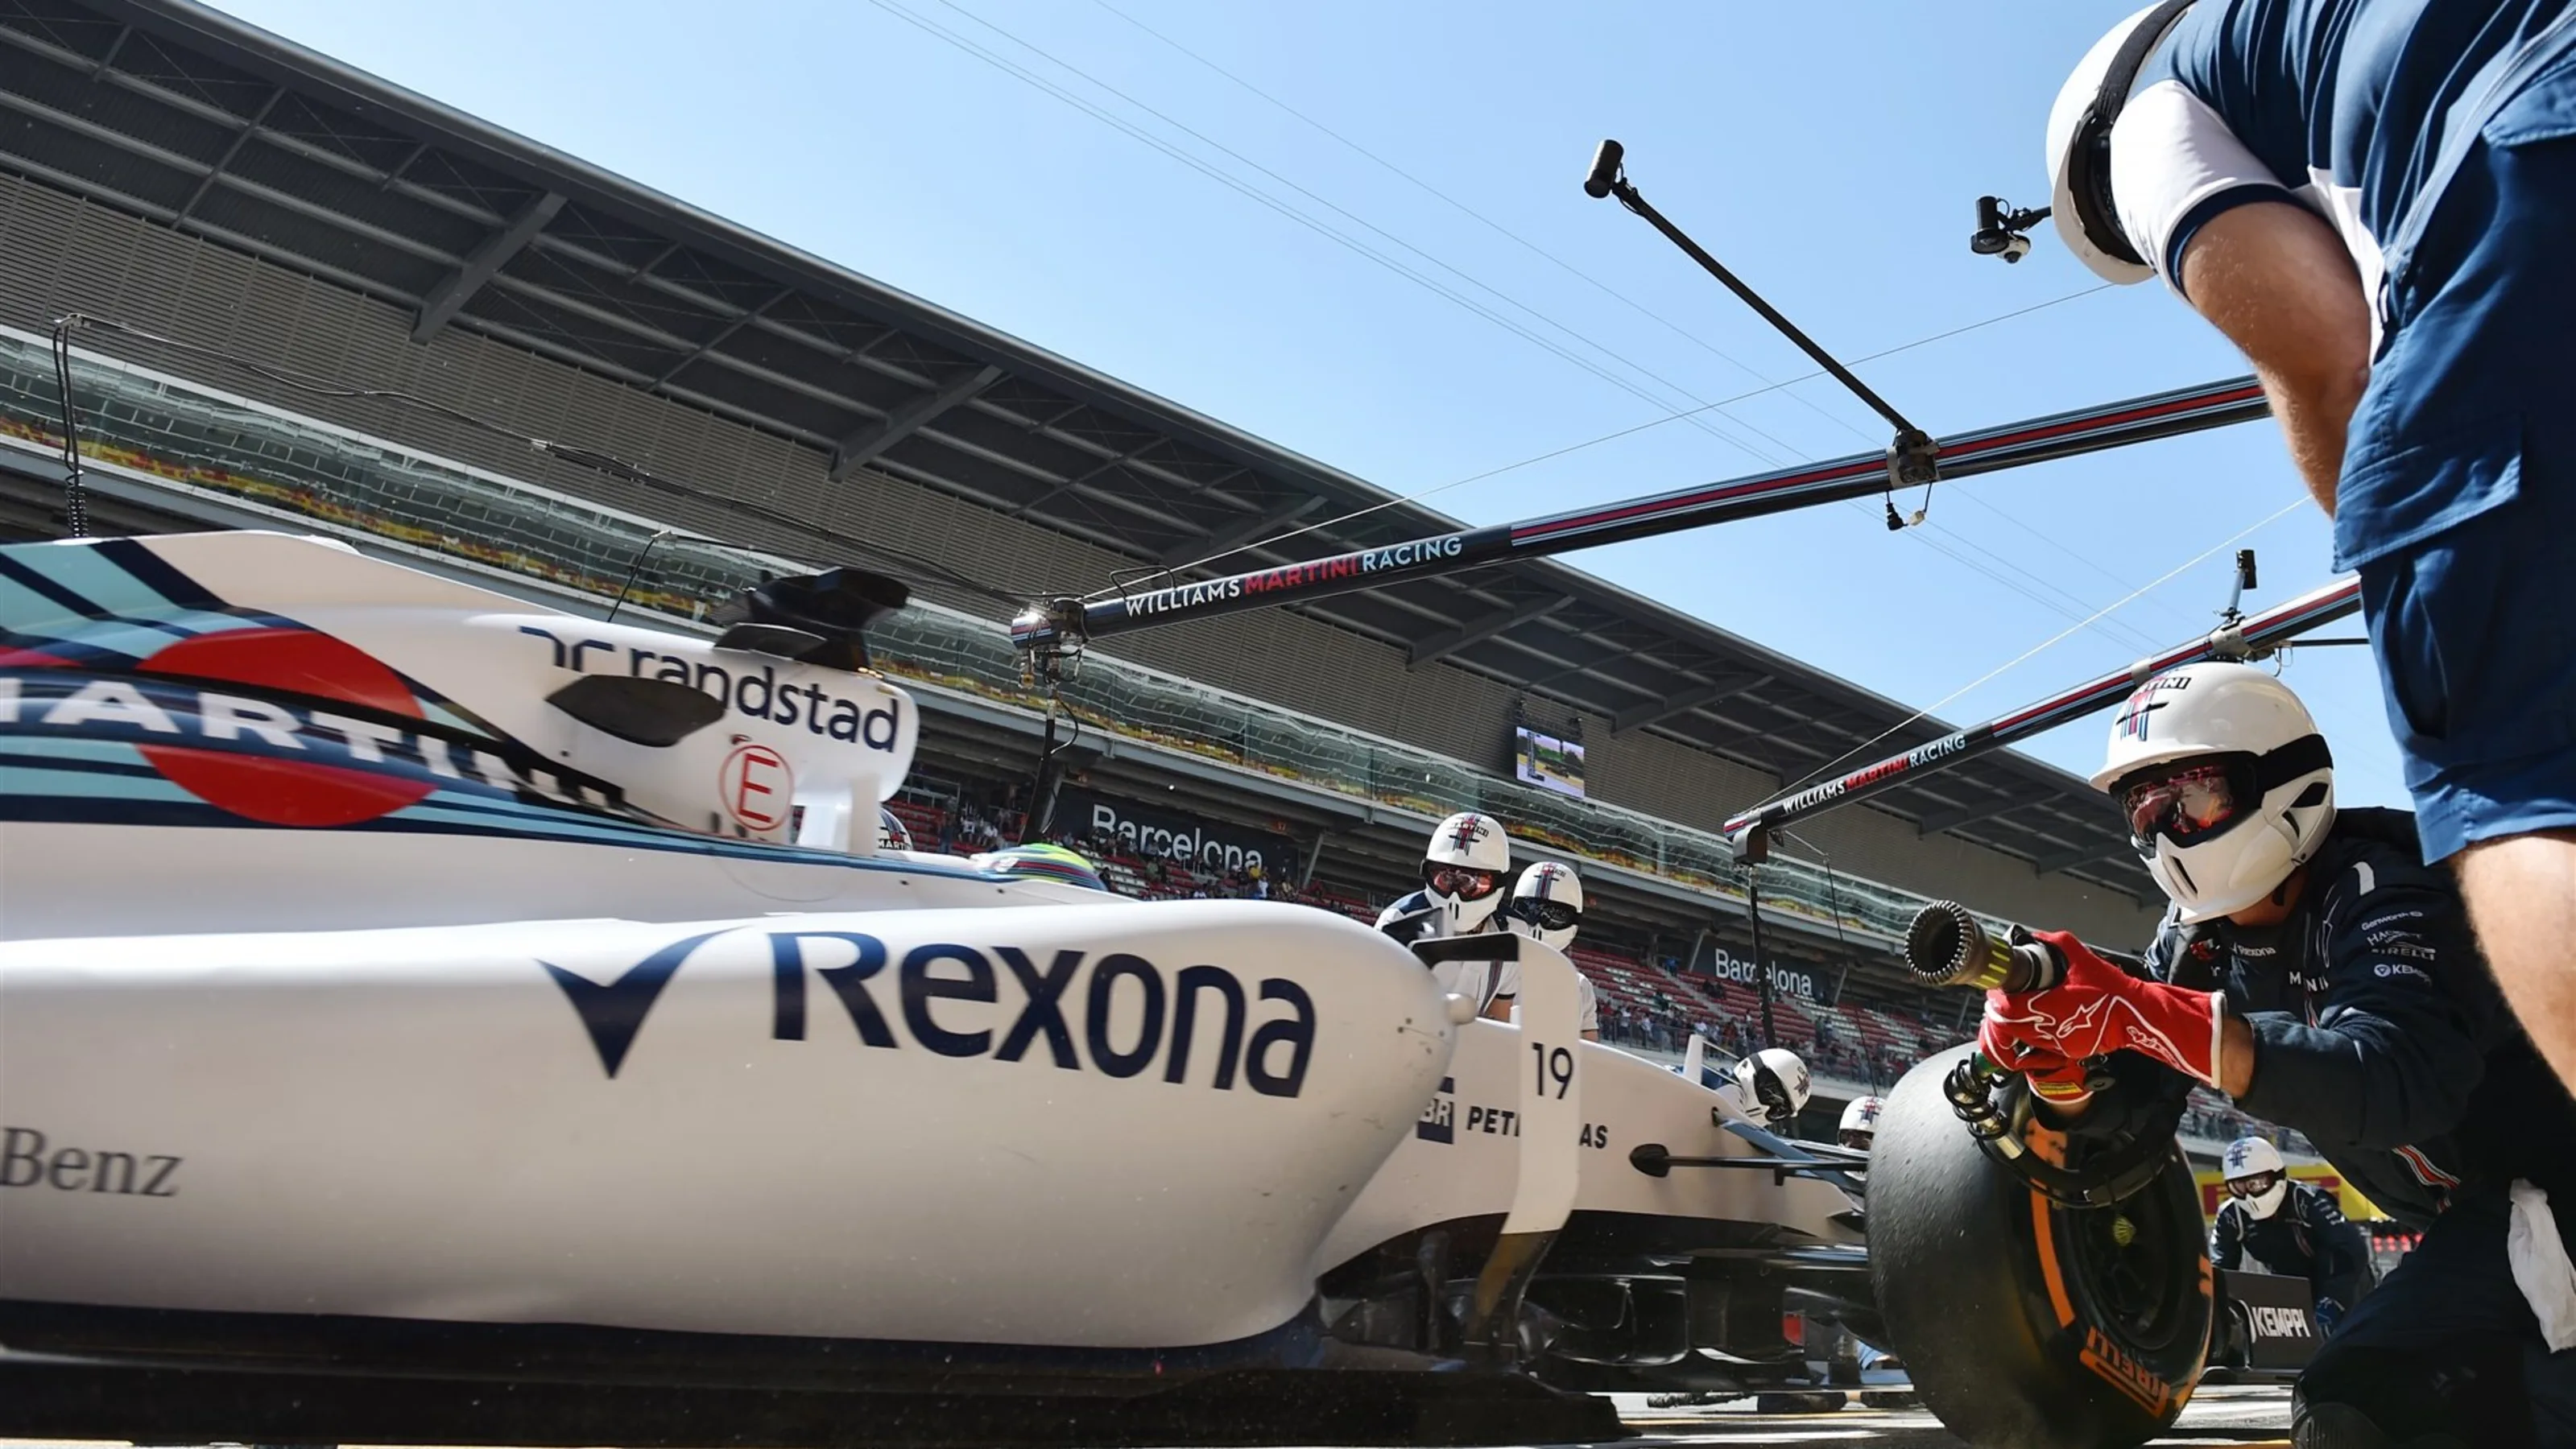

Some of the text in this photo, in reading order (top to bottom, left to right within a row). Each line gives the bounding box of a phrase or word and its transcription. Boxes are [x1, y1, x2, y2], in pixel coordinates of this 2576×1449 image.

[1126, 536, 1463, 618] WILLIAMS MARTINI RACING
[631, 647, 899, 753] randstad
[737, 751, 779, 824] E
[1782, 733, 1966, 815] WILLIAMS MARTINI RACING
[1092, 803, 1263, 870] Barcelona
[768, 931, 1317, 1099] Rexona
[1532, 1042, 1574, 1100] 19
[0, 1126, 184, 1198] Benz
[1466, 1105, 1608, 1150] PETAS
[2251, 1306, 2311, 1337] KEMPPI
